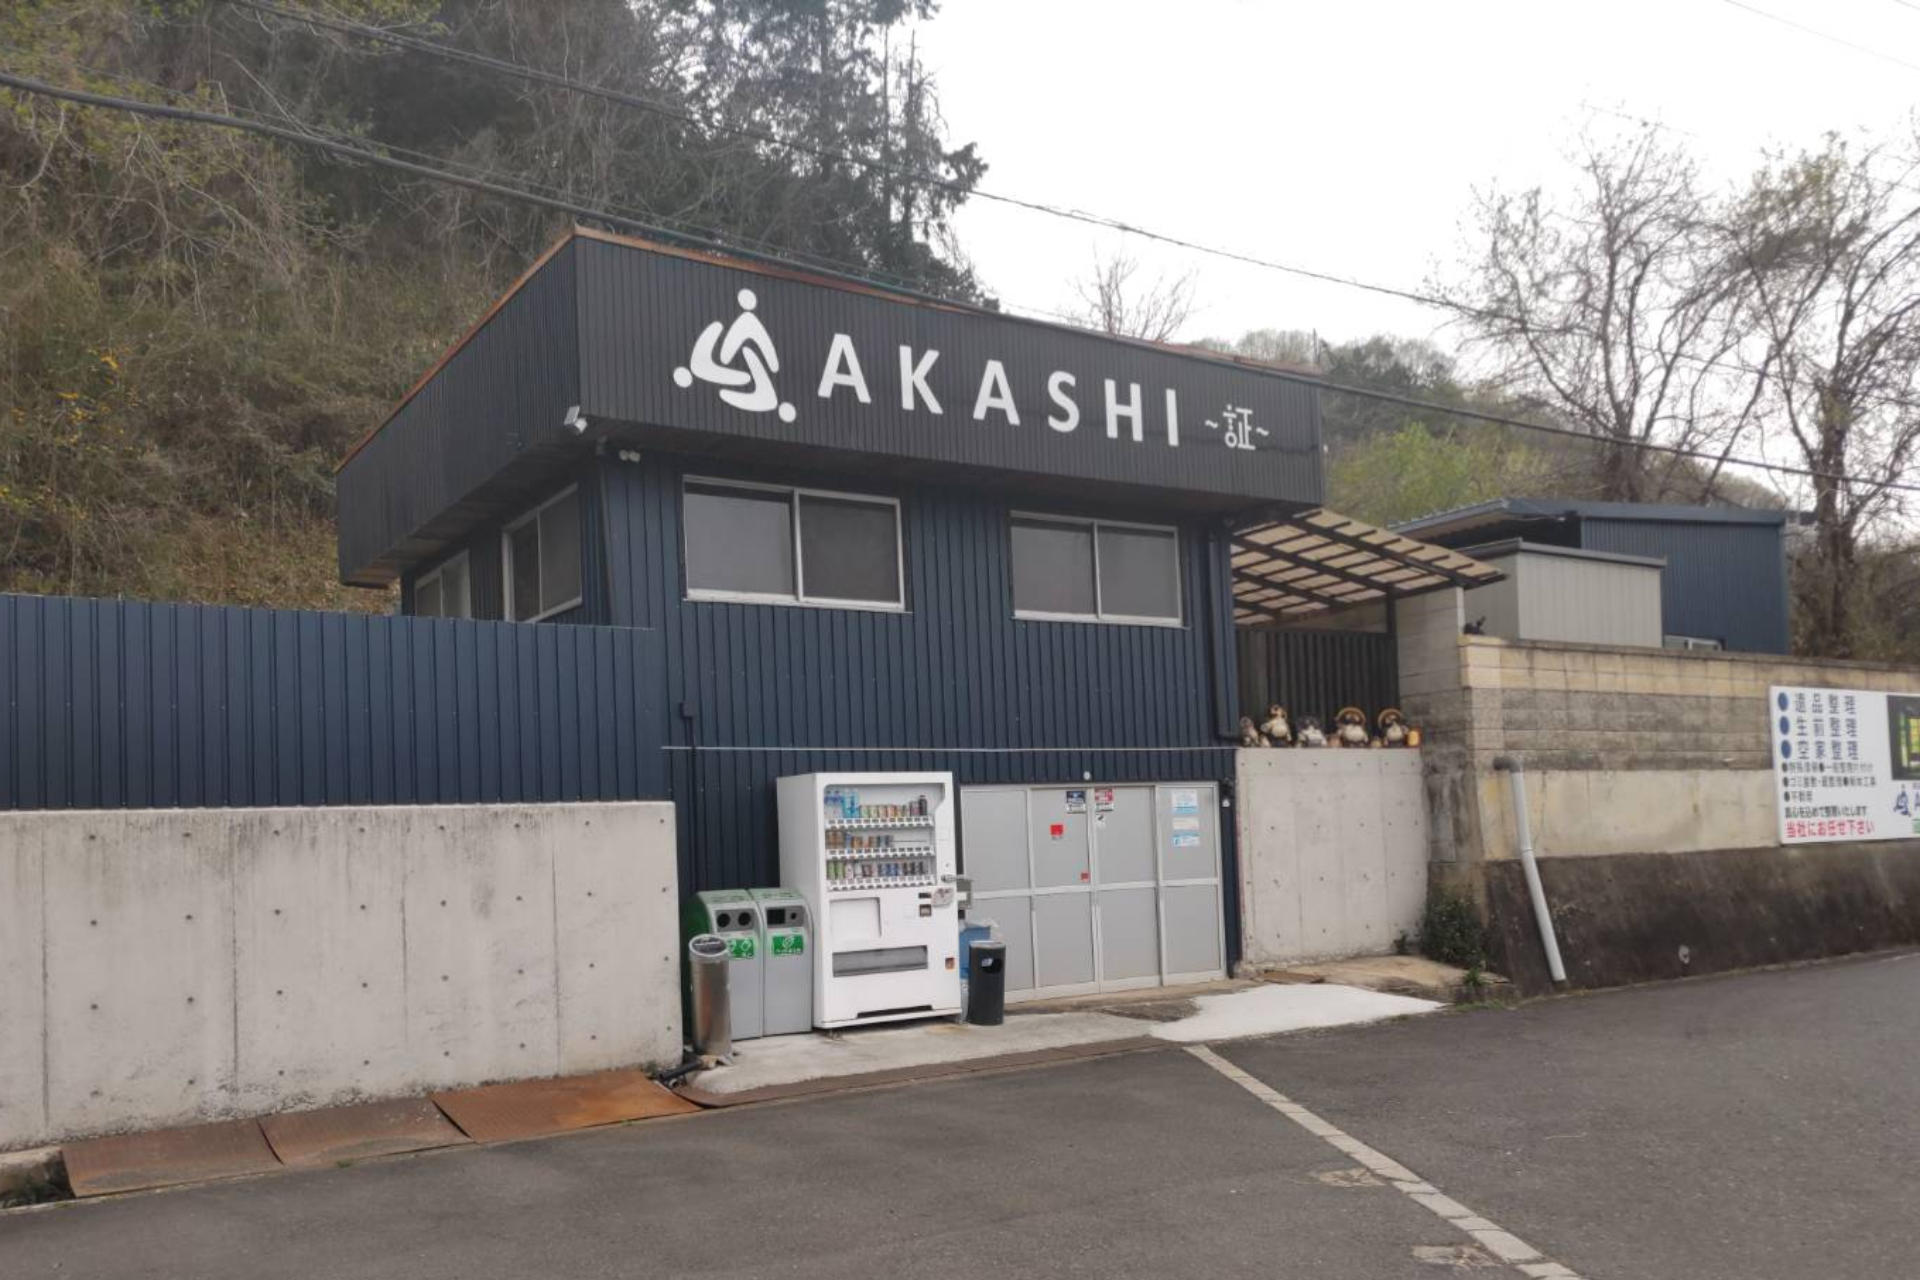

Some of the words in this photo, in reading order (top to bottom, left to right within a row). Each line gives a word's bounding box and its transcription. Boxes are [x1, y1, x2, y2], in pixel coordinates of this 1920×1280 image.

[817, 333, 1179, 446] AKASHI
[1786, 820, 1875, 839] 当社にお任せ下さい
